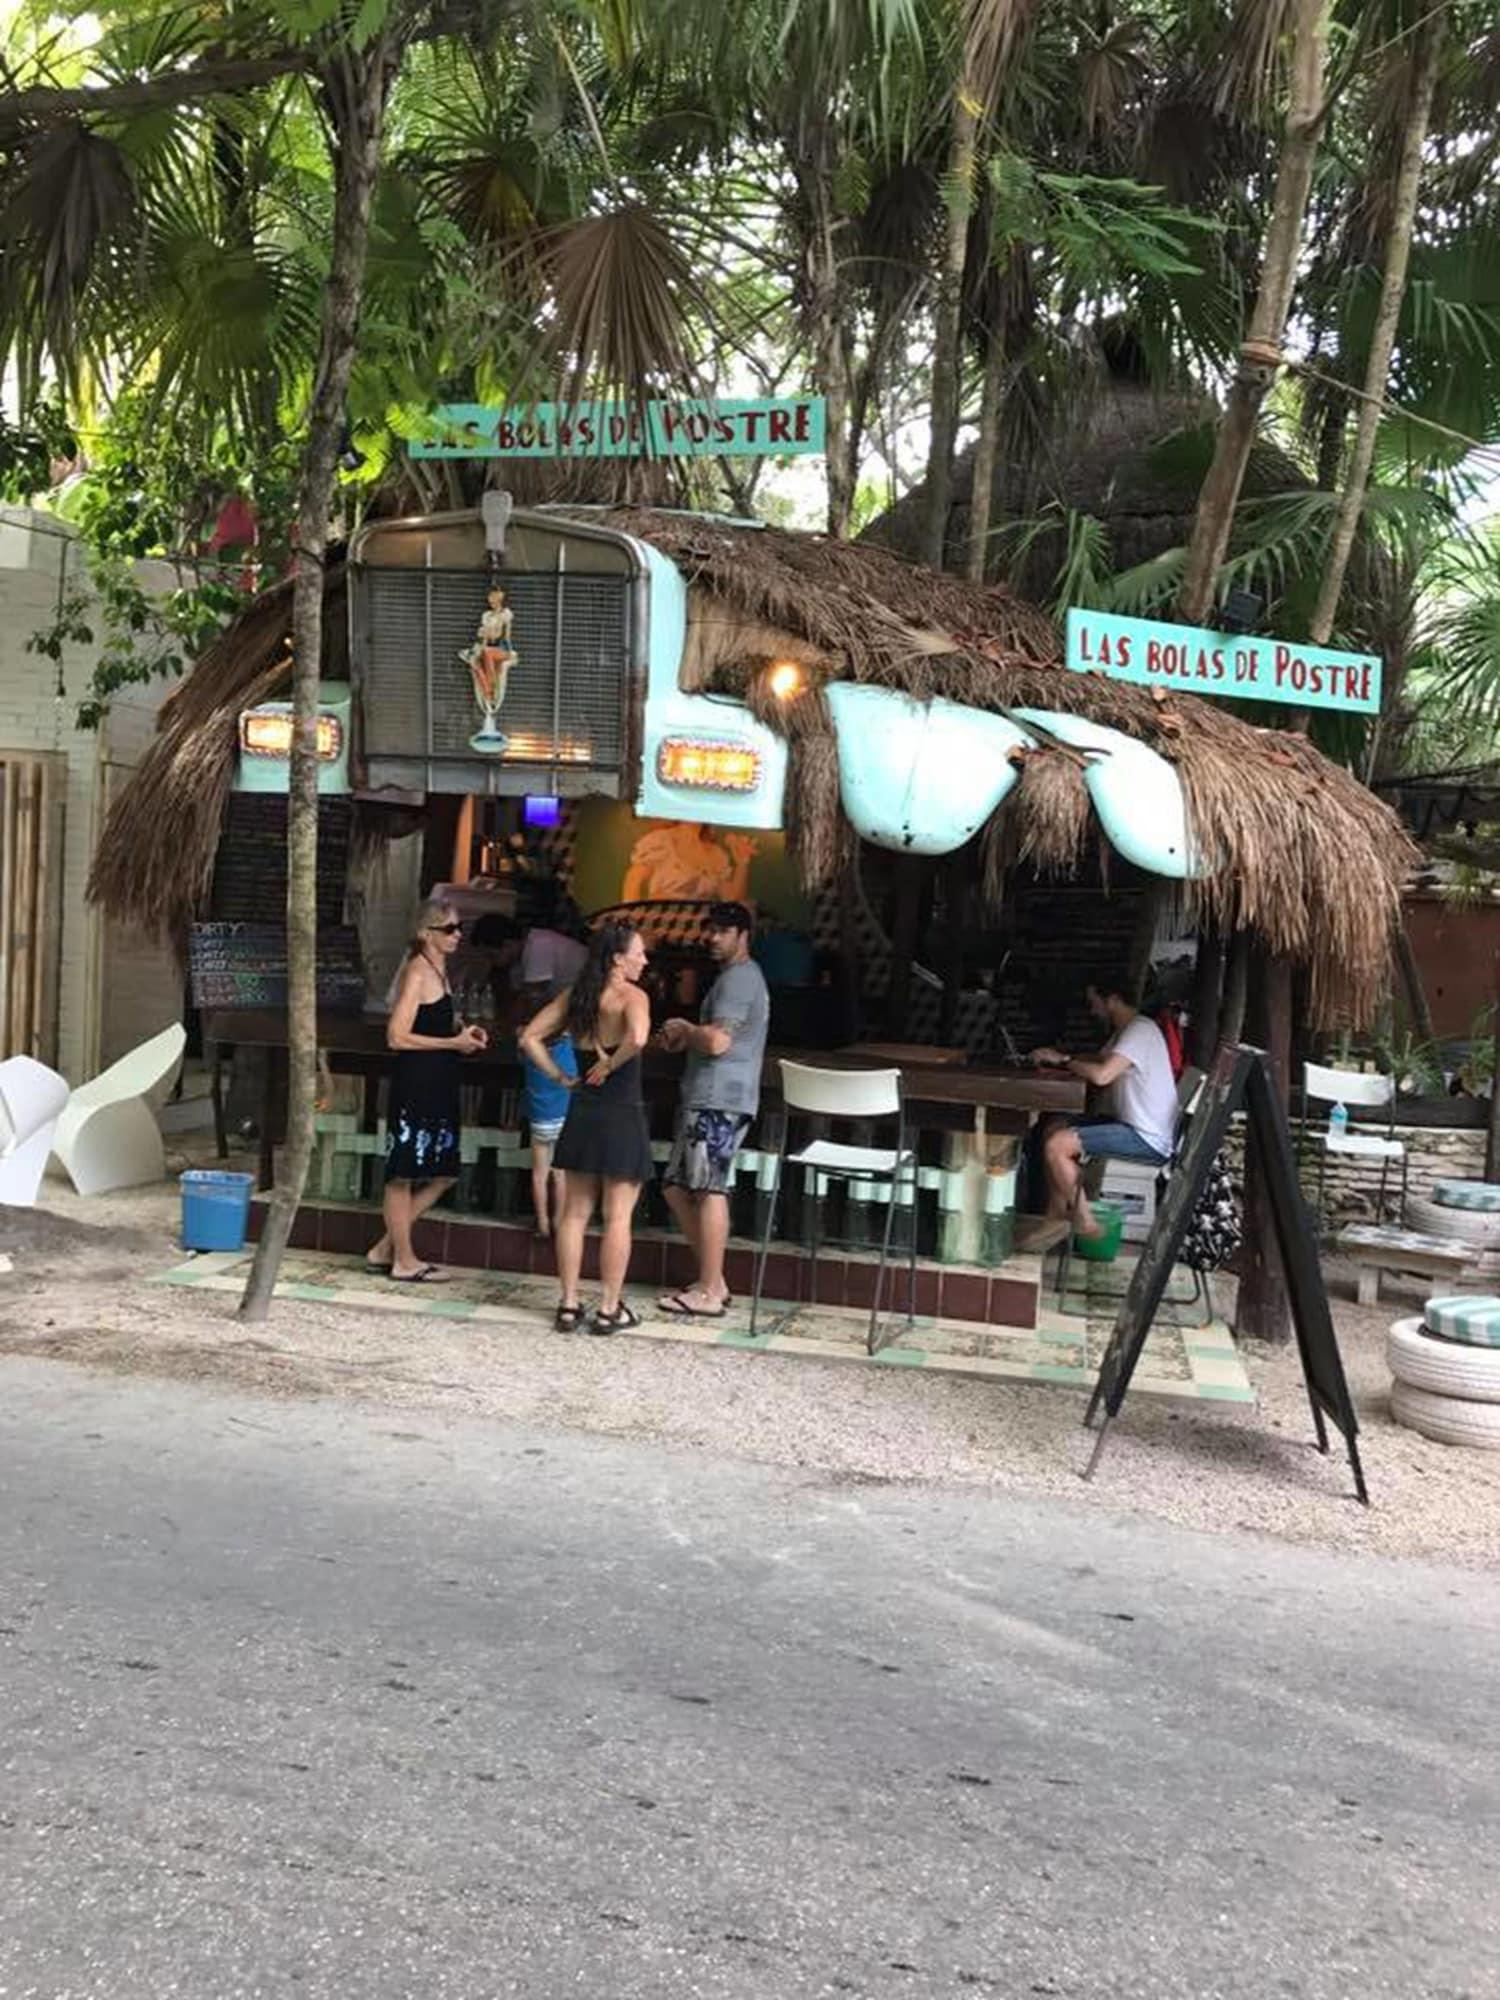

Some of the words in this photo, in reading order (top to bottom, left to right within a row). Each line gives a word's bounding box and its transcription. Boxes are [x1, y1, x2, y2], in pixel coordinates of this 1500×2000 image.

[1080, 627, 1132, 667] LAS
[1147, 640, 1224, 681] BOLAS
[1235, 649, 1259, 682] DE
[1275, 645, 1371, 701] POSTRE
